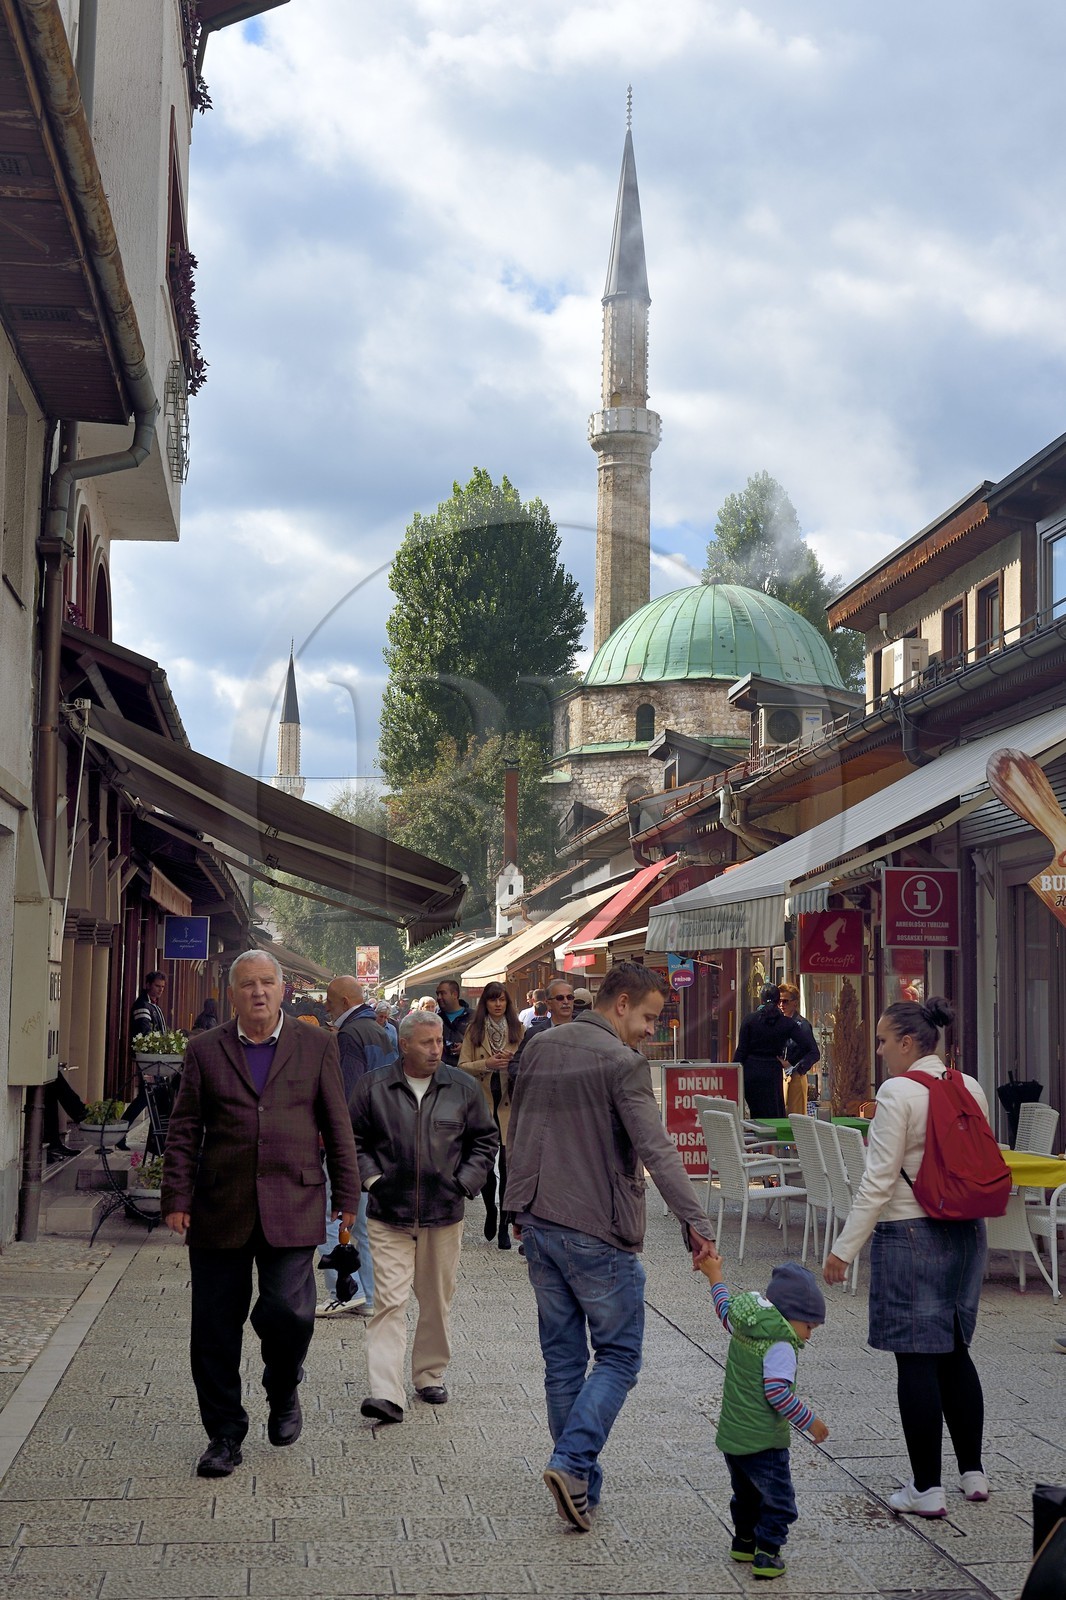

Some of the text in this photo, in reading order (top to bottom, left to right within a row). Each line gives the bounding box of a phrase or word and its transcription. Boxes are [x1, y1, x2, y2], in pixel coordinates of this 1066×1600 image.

[1040, 875, 1066, 892] BU
[677, 1076, 723, 1091] DNEVNI
[670, 1132, 707, 1146] BOSA
